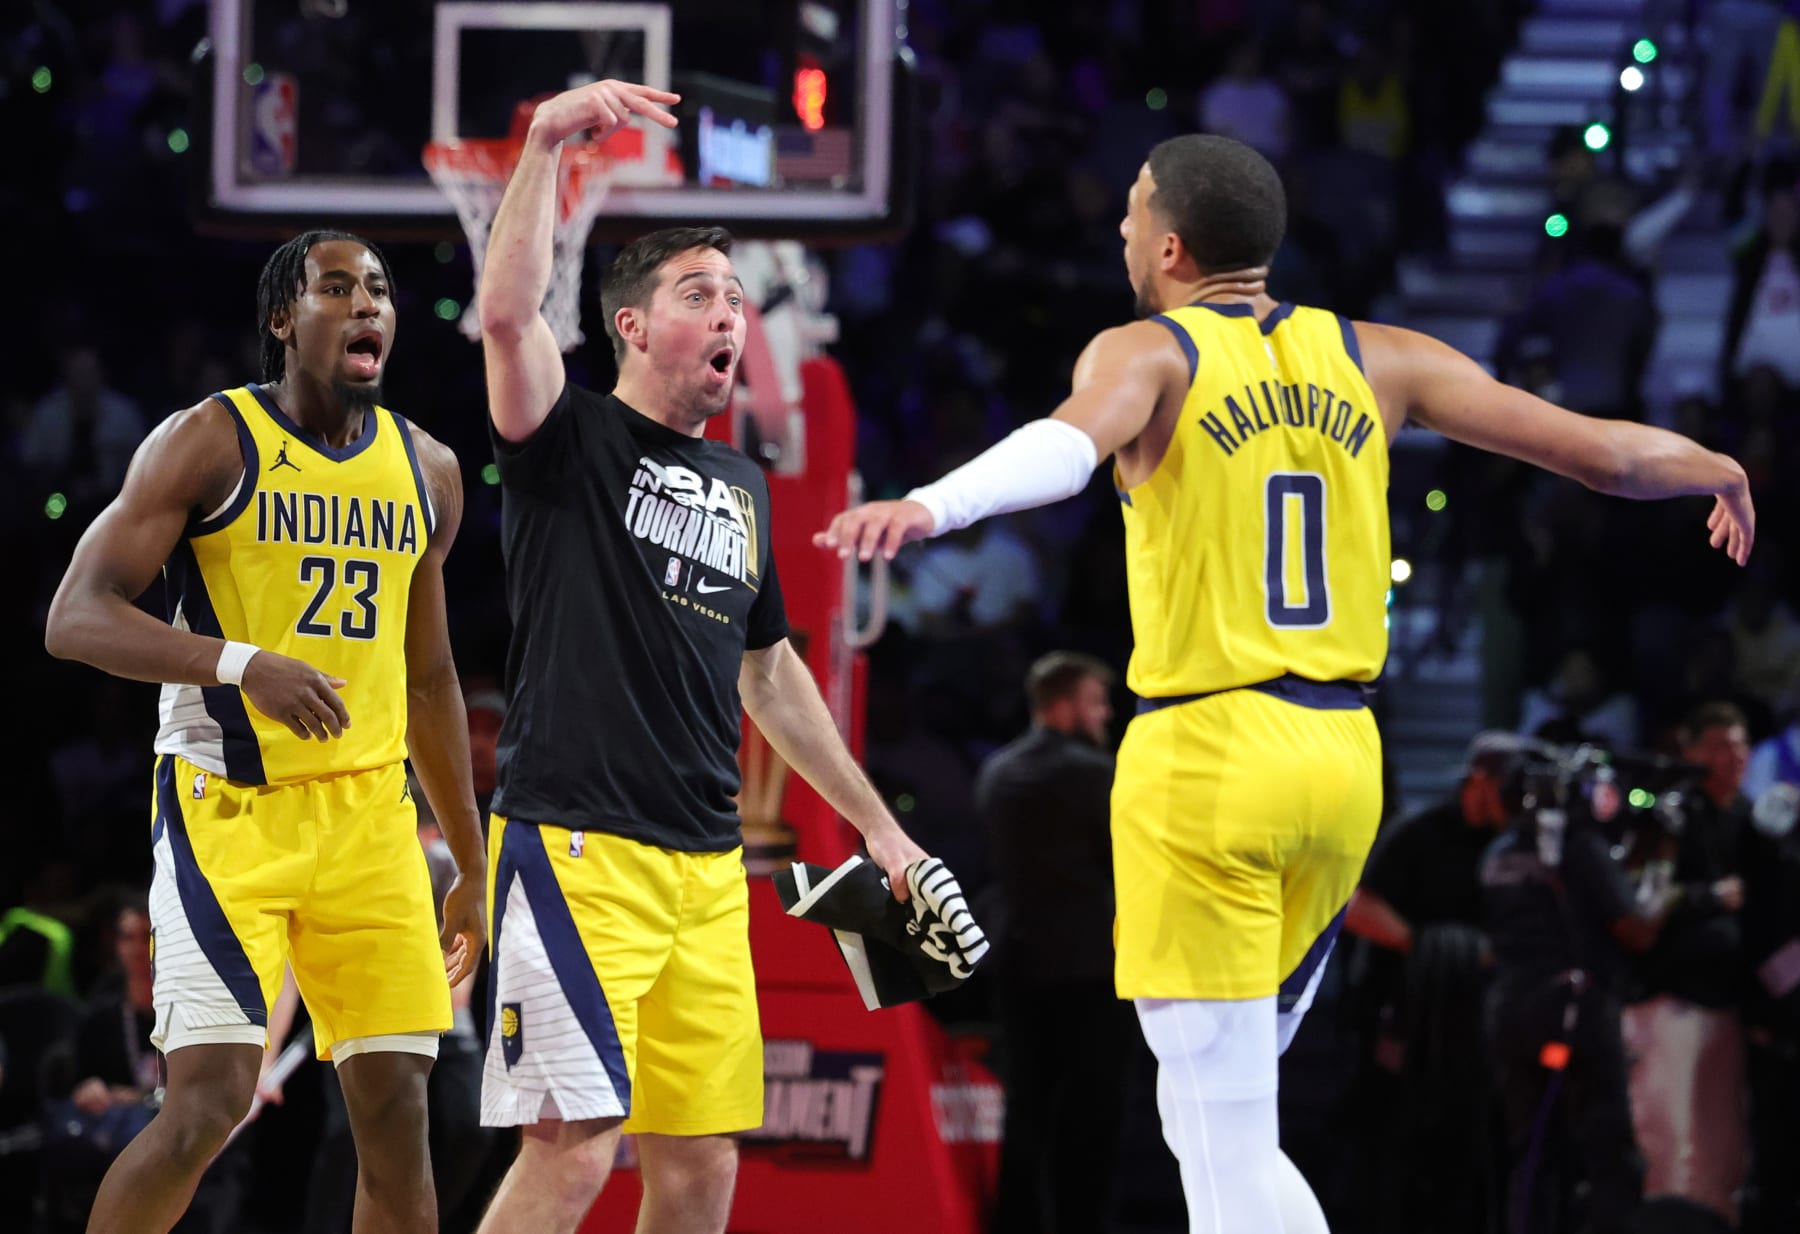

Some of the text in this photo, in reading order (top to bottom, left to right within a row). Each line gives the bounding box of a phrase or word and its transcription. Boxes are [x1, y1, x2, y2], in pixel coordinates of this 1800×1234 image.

[1198, 379, 1375, 459] HALIURTON
[257, 490, 417, 555] INDIANA
[625, 487, 748, 583] TOURNAMENT
[1264, 471, 1332, 630] 0
[296, 556, 380, 640] 23
[661, 591, 730, 624] LAS VEGAS
